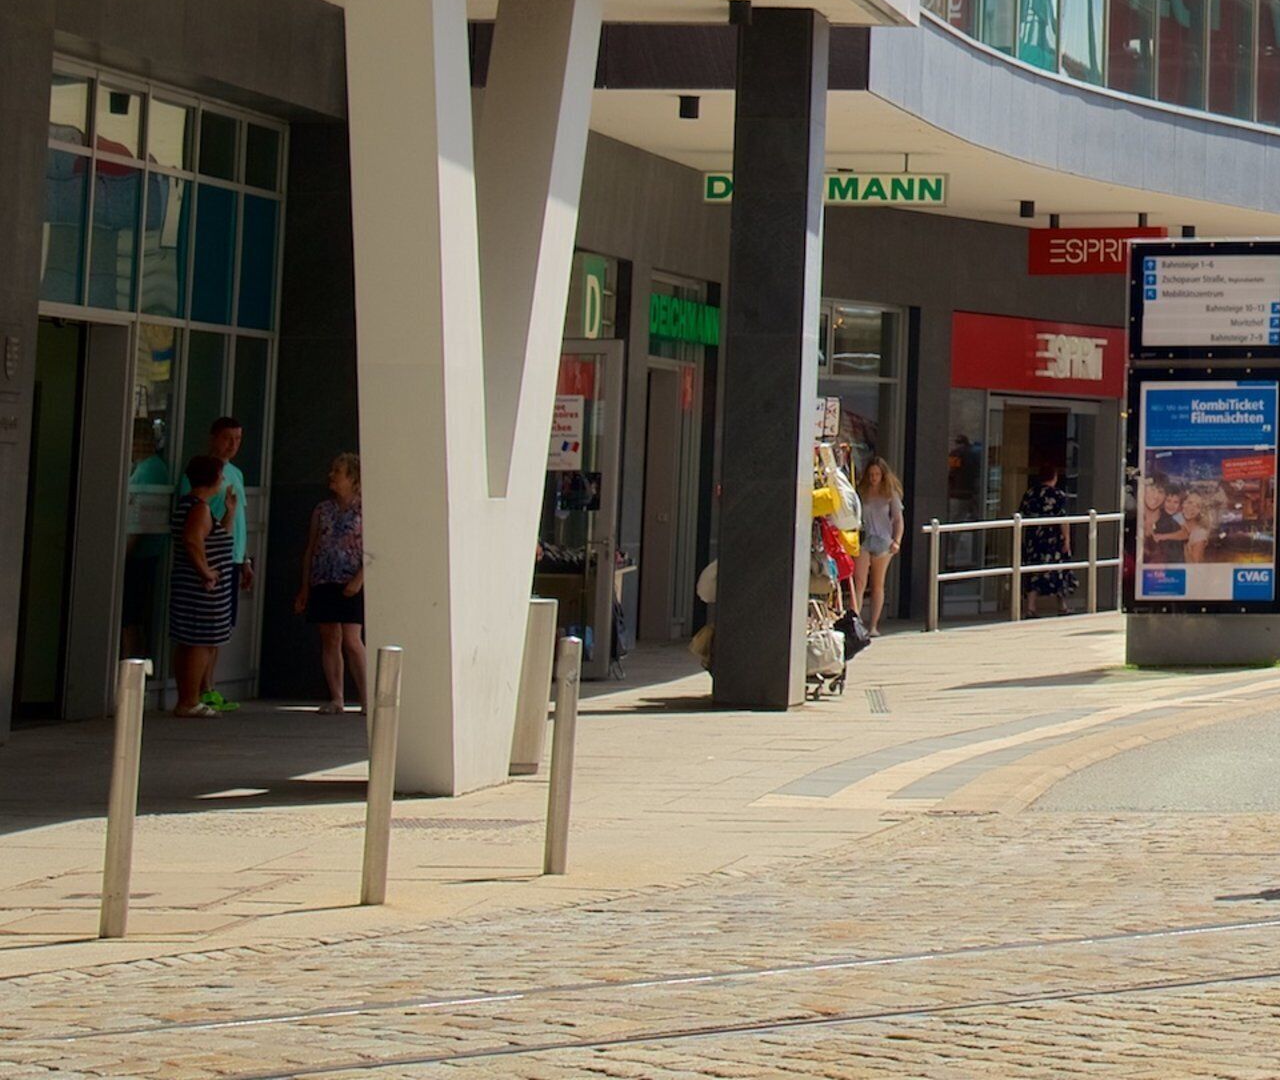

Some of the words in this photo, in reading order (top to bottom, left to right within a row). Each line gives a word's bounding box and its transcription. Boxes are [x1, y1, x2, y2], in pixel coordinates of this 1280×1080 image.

[706, 176, 943, 201] DMANN
[1162, 260, 1199, 270] Bahnsteige
[1162, 276, 1200, 285] Zschopauer
[1206, 304, 1243, 313] Bahnsteige
[1211, 334, 1249, 343] Bahnsteige
[1035, 333, 1108, 381] ESPRIT
[1191, 399, 1264, 411] KombiTicket
[1191, 411, 1264, 424] Filmnächten
[1237, 571, 1269, 582] CVAG
